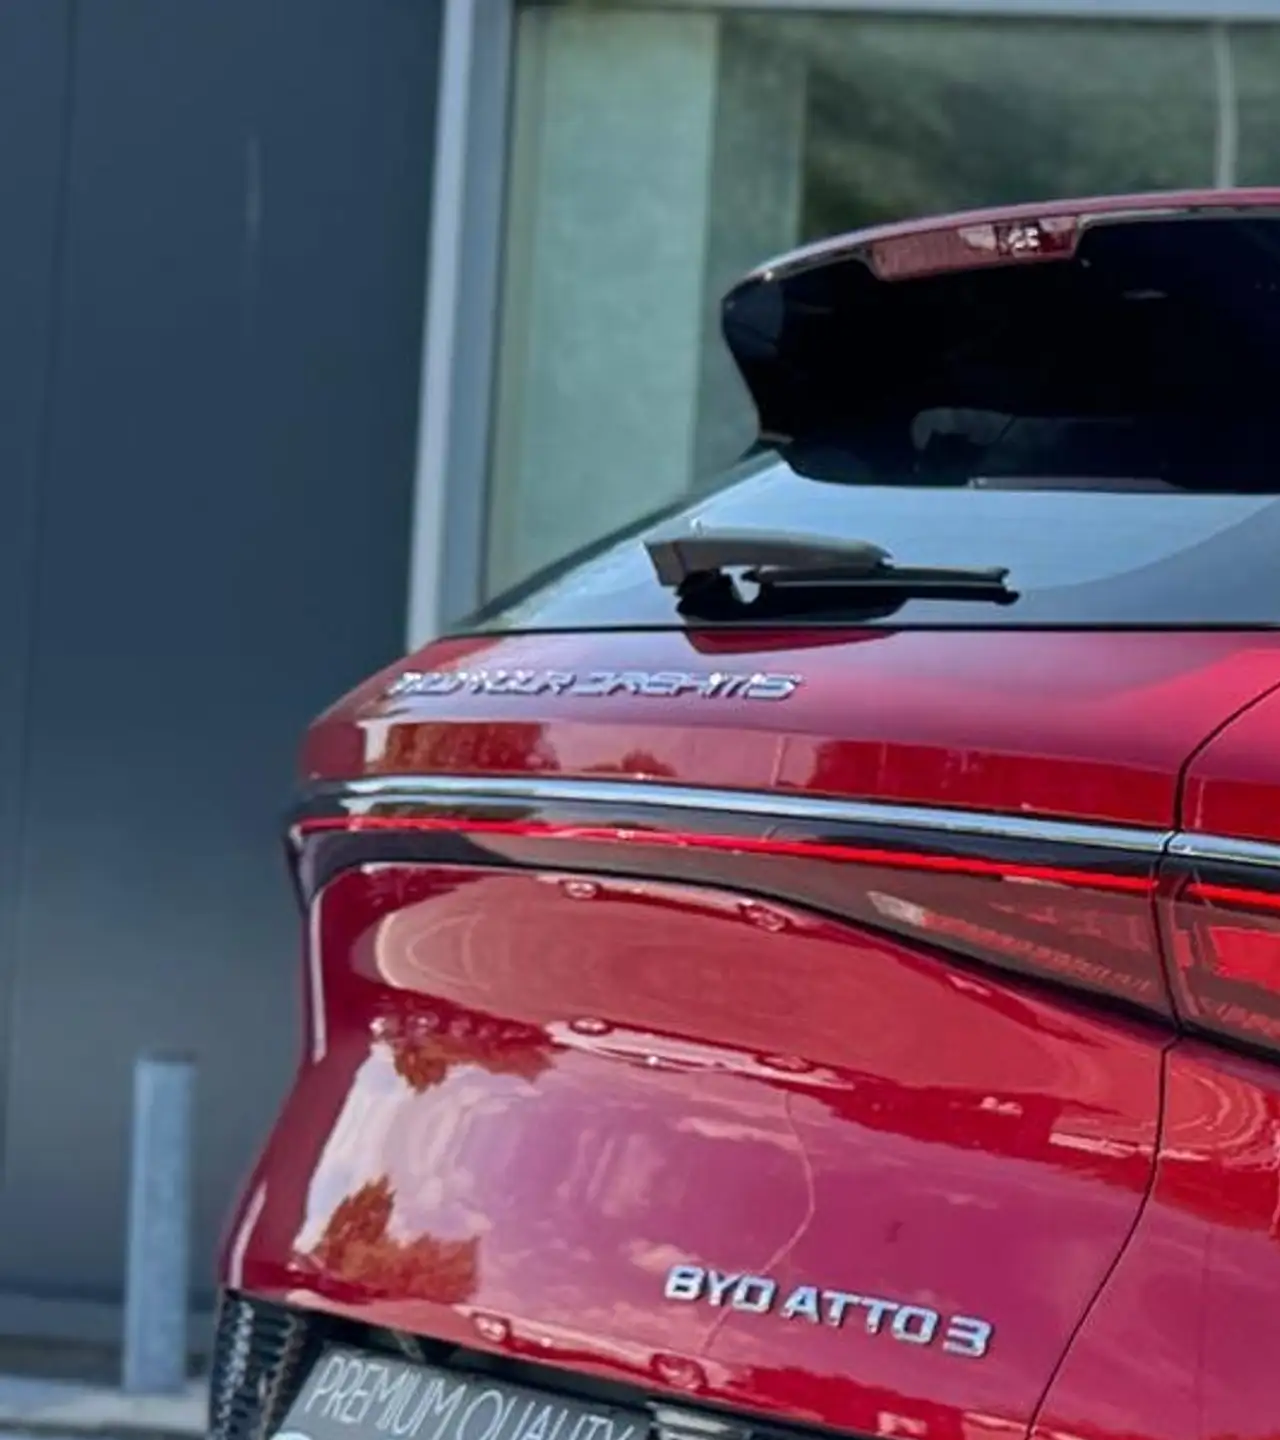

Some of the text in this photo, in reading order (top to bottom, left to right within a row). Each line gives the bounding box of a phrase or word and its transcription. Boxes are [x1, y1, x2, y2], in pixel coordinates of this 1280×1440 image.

[664, 1264, 993, 1359] BYD ATTO 3
